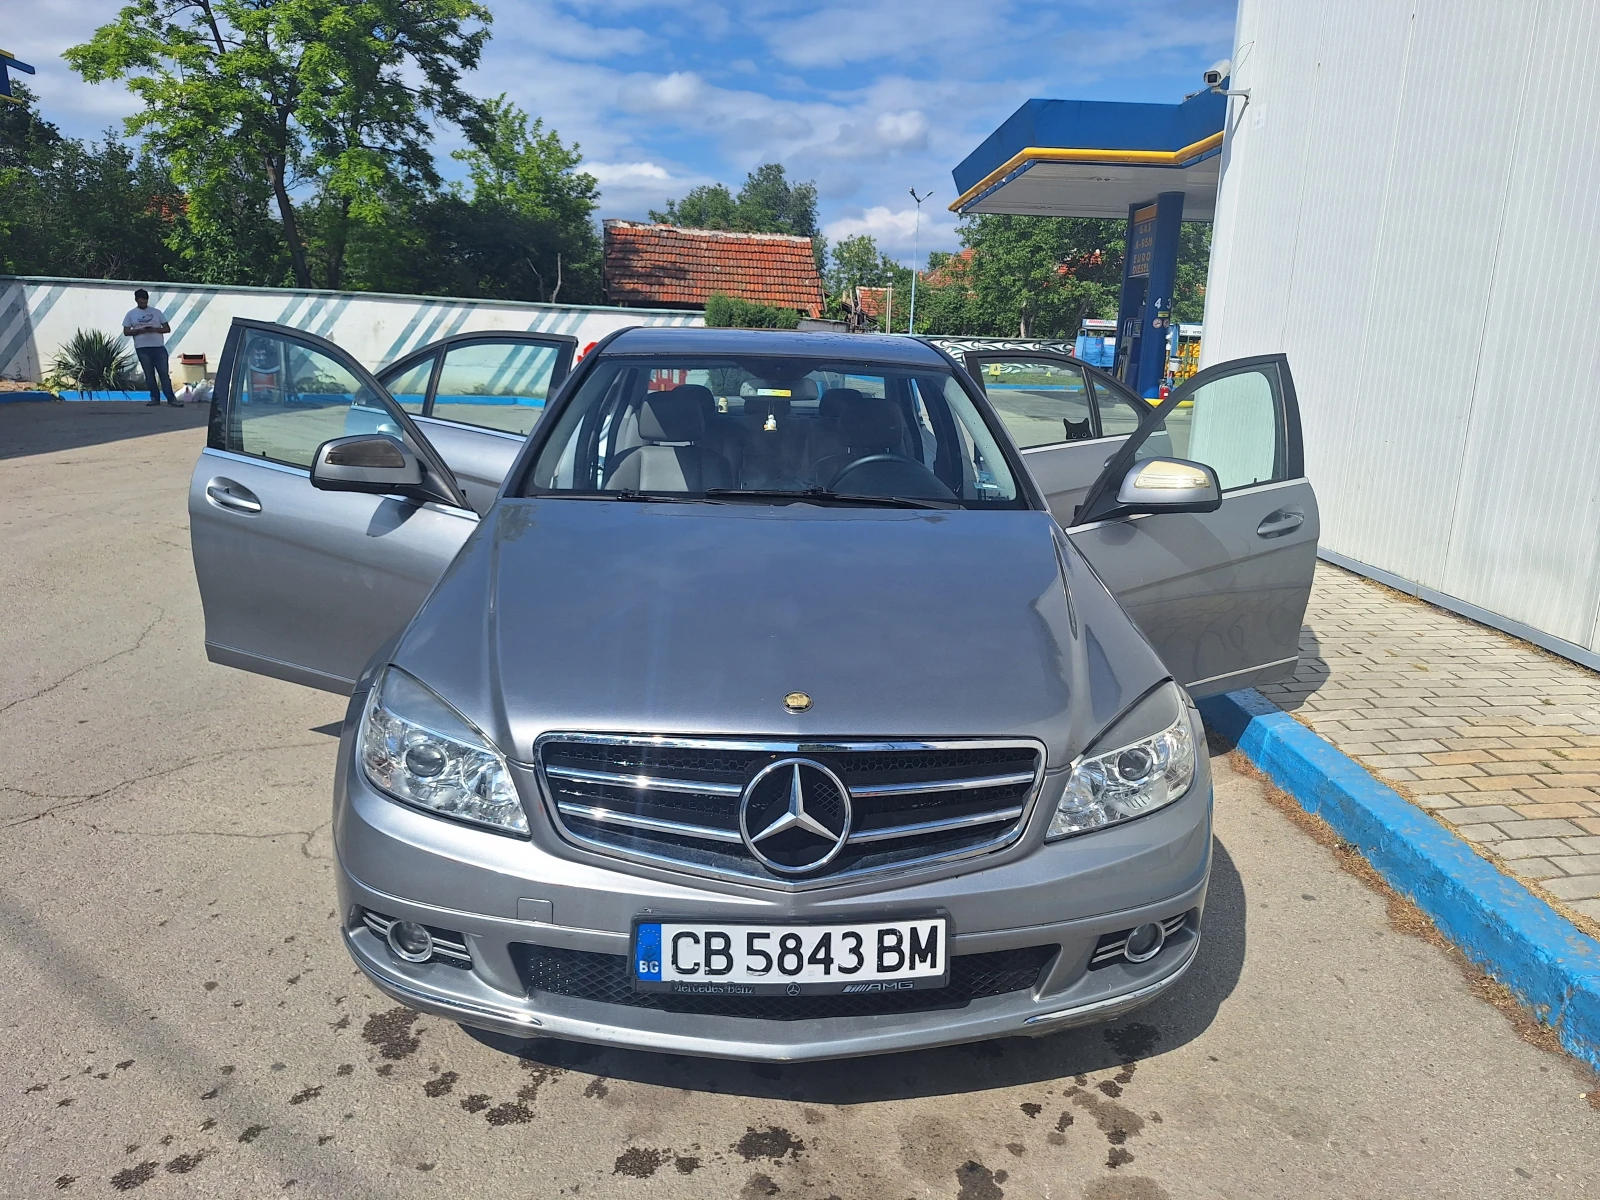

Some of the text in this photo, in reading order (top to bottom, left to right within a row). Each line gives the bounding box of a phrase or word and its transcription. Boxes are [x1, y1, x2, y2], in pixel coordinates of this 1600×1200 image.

[1133, 252, 1151, 264] EURO
[1132, 263, 1149, 275] DIESEL
[1154, 297, 1162, 309] 4
[671, 925, 939, 977] CB 5843 BM
[638, 960, 659, 974] BG
[865, 980, 914, 992] AMG
